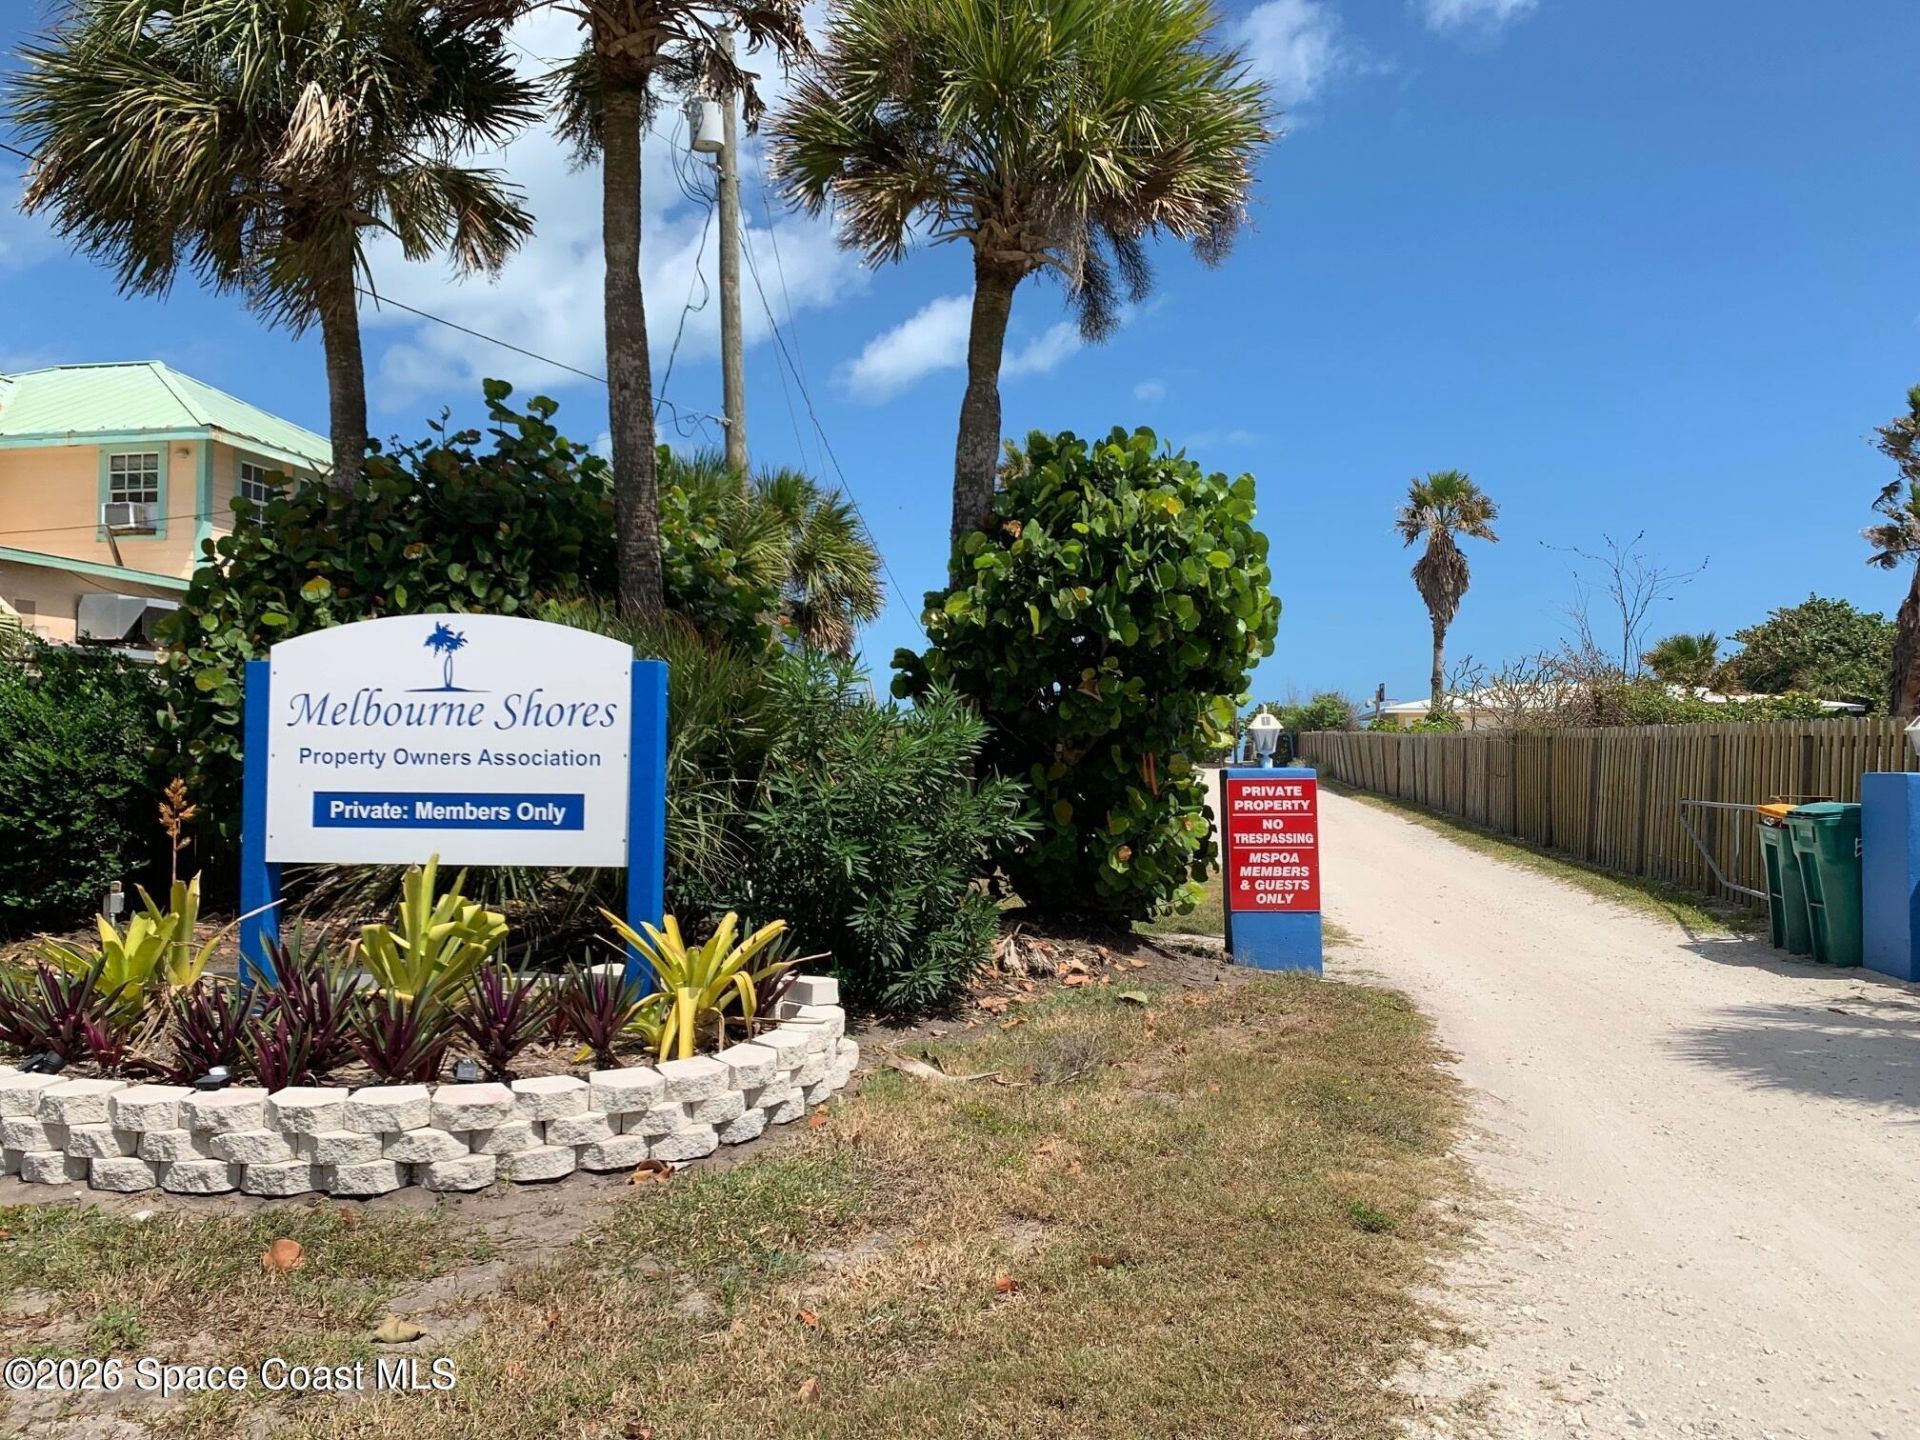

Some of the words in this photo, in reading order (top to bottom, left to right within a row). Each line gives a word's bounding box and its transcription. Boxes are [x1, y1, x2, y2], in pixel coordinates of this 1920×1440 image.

[287, 688, 485, 728] Melbourne
[494, 688, 618, 731] Shores
[299, 748, 386, 770] Property
[393, 748, 471, 766] Owners
[478, 749, 601, 767] Association
[1242, 786, 1302, 797] PRIVATE
[1234, 800, 1310, 811] PROPERTY
[330, 801, 408, 820] Private:
[415, 802, 511, 821] Members
[516, 802, 566, 826] Only
[1262, 819, 1284, 830] NO
[1233, 833, 1314, 844] TRESPASSING
[1249, 852, 1300, 864] MSPOA
[1240, 866, 1310, 877] MEMBERS
[1240, 880, 1251, 891] &
[1255, 880, 1310, 891] GUESTS
[1256, 893, 1295, 905] ONLY
